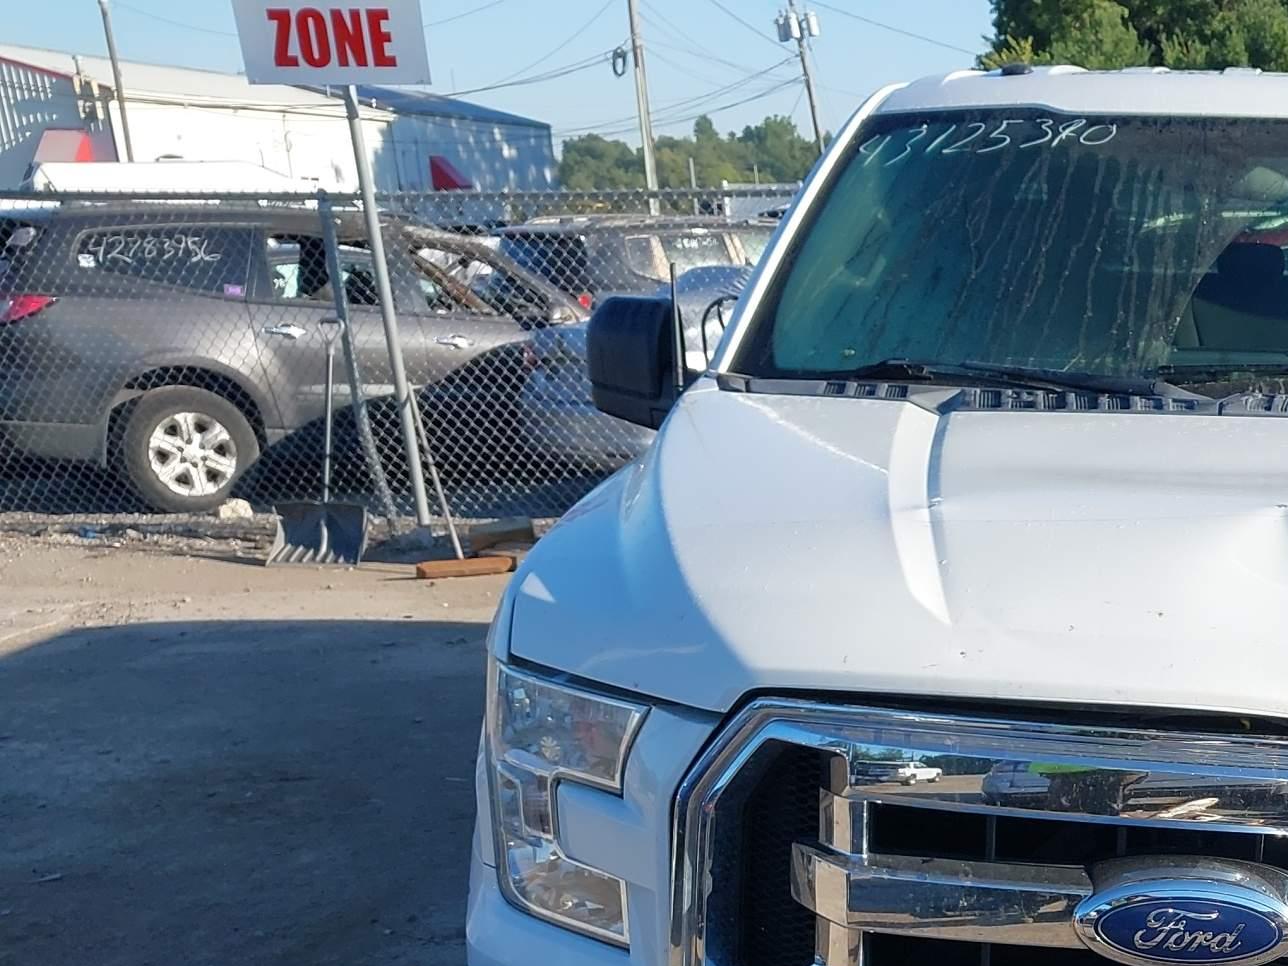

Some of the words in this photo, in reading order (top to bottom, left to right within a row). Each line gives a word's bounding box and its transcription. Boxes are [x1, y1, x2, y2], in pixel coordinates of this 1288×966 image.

[266, 7, 397, 68] ZONE
[89, 233, 222, 264] 42783956
[1133, 908, 1245, 952] Ford
